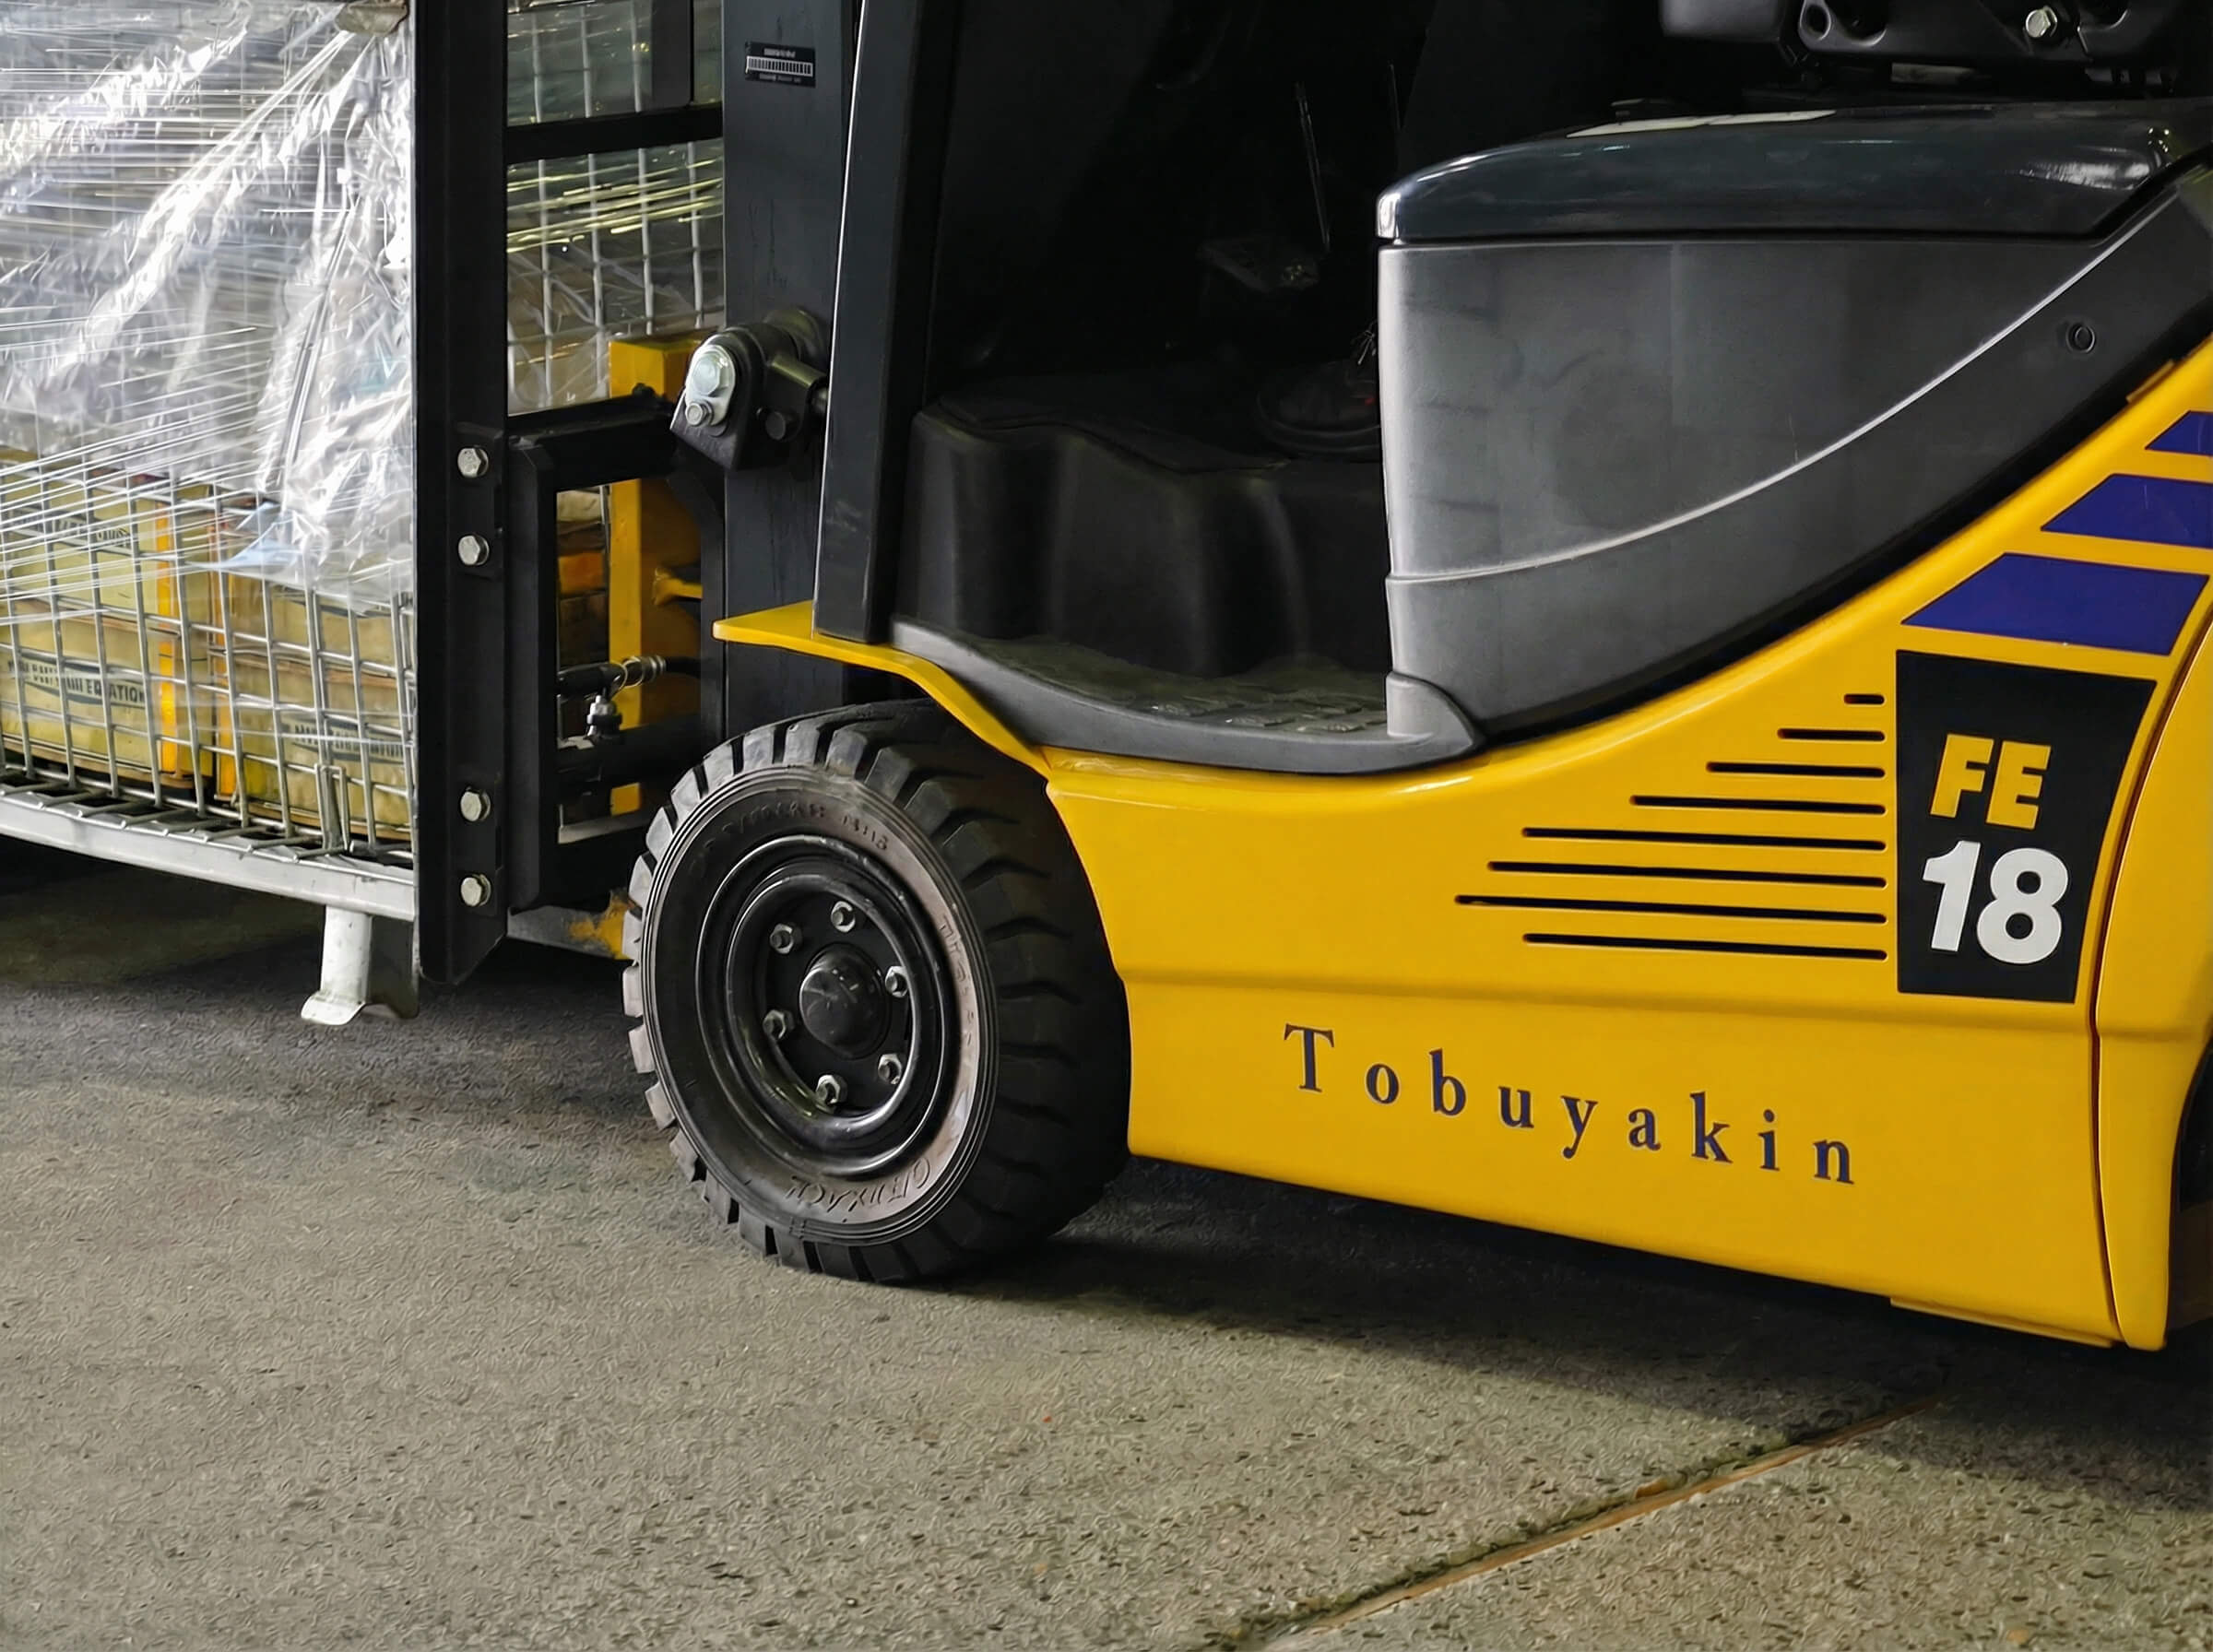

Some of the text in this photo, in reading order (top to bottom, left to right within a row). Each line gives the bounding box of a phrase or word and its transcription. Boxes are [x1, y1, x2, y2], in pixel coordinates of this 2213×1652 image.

[1929, 733, 2052, 830] FE
[1923, 840, 2069, 964] 18
[1284, 1023, 1855, 1186] Tobuyakin
